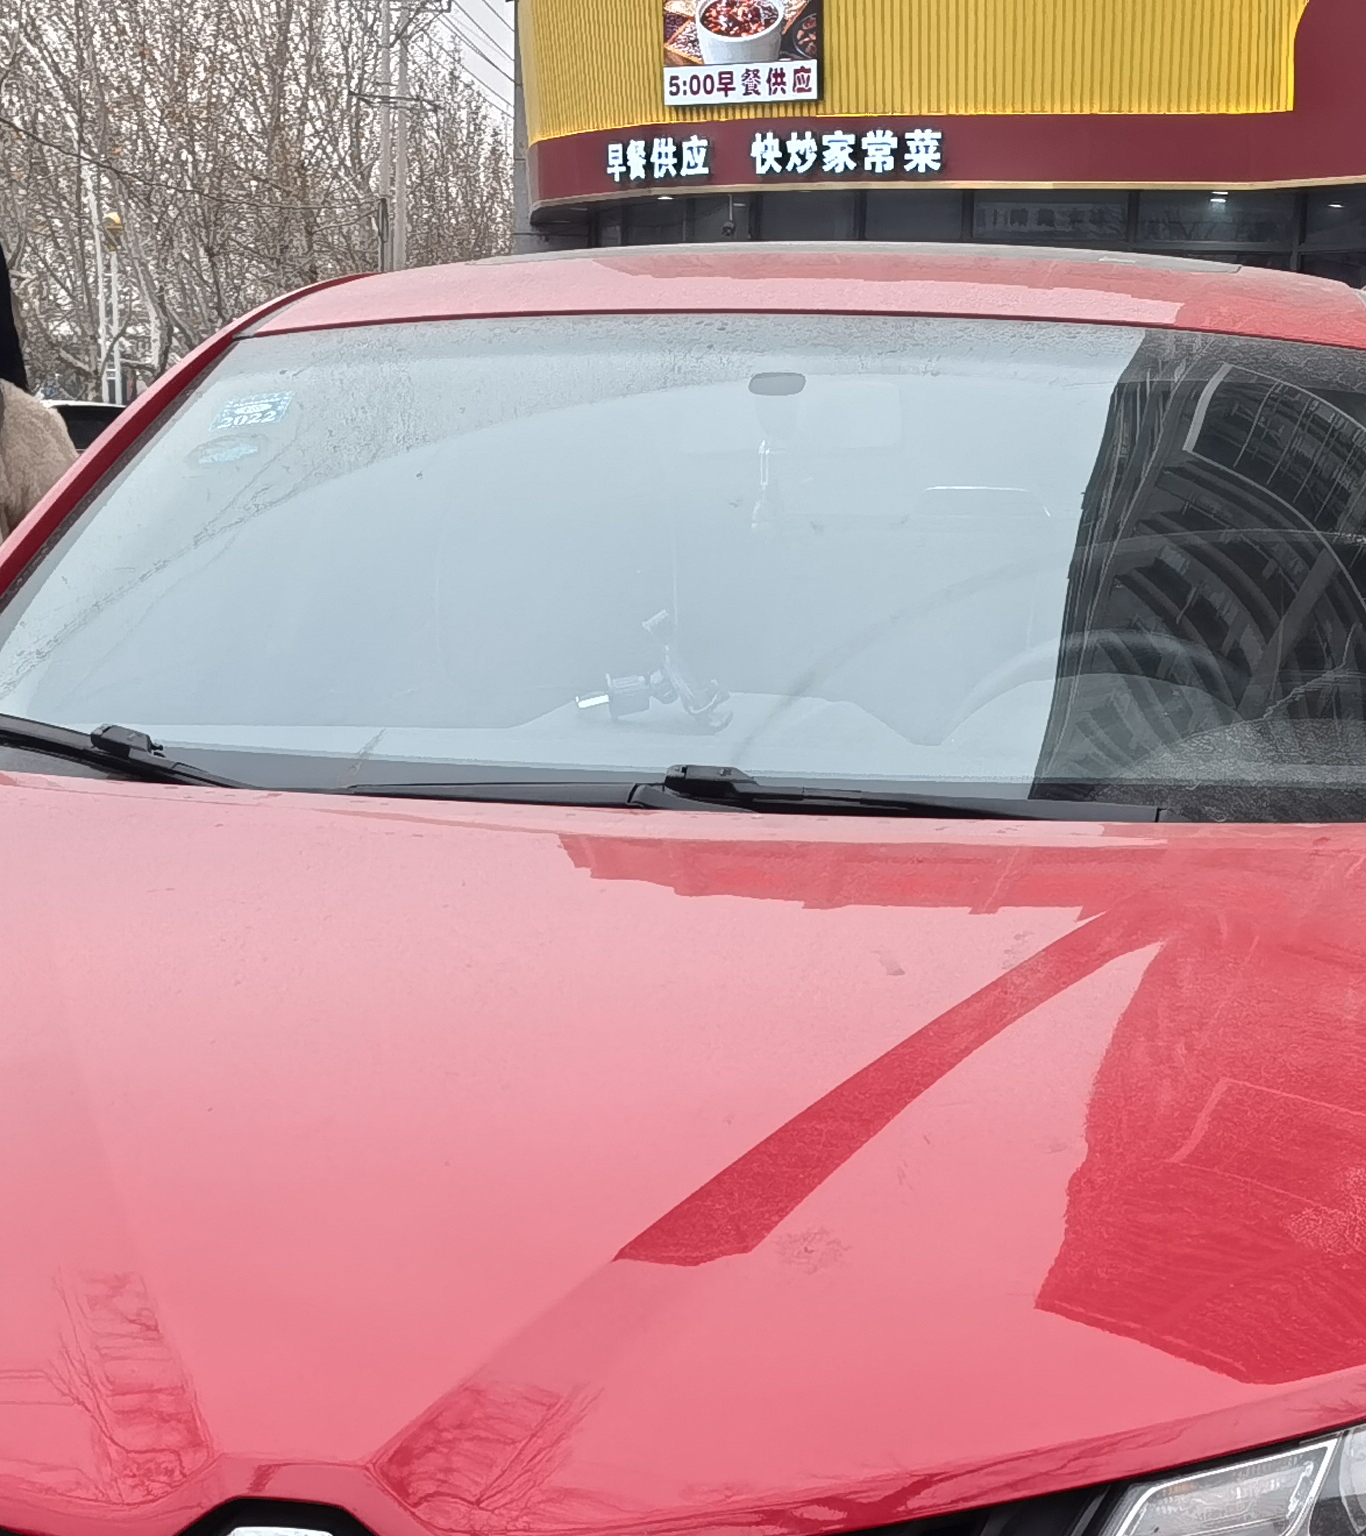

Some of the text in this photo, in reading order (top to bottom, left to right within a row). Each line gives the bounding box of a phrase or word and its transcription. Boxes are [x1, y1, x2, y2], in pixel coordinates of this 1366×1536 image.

[668, 65, 813, 98] 5:00早餐供应
[605, 128, 943, 181] 早餐供应 快炒家常菜
[216, 411, 277, 430] 2022
